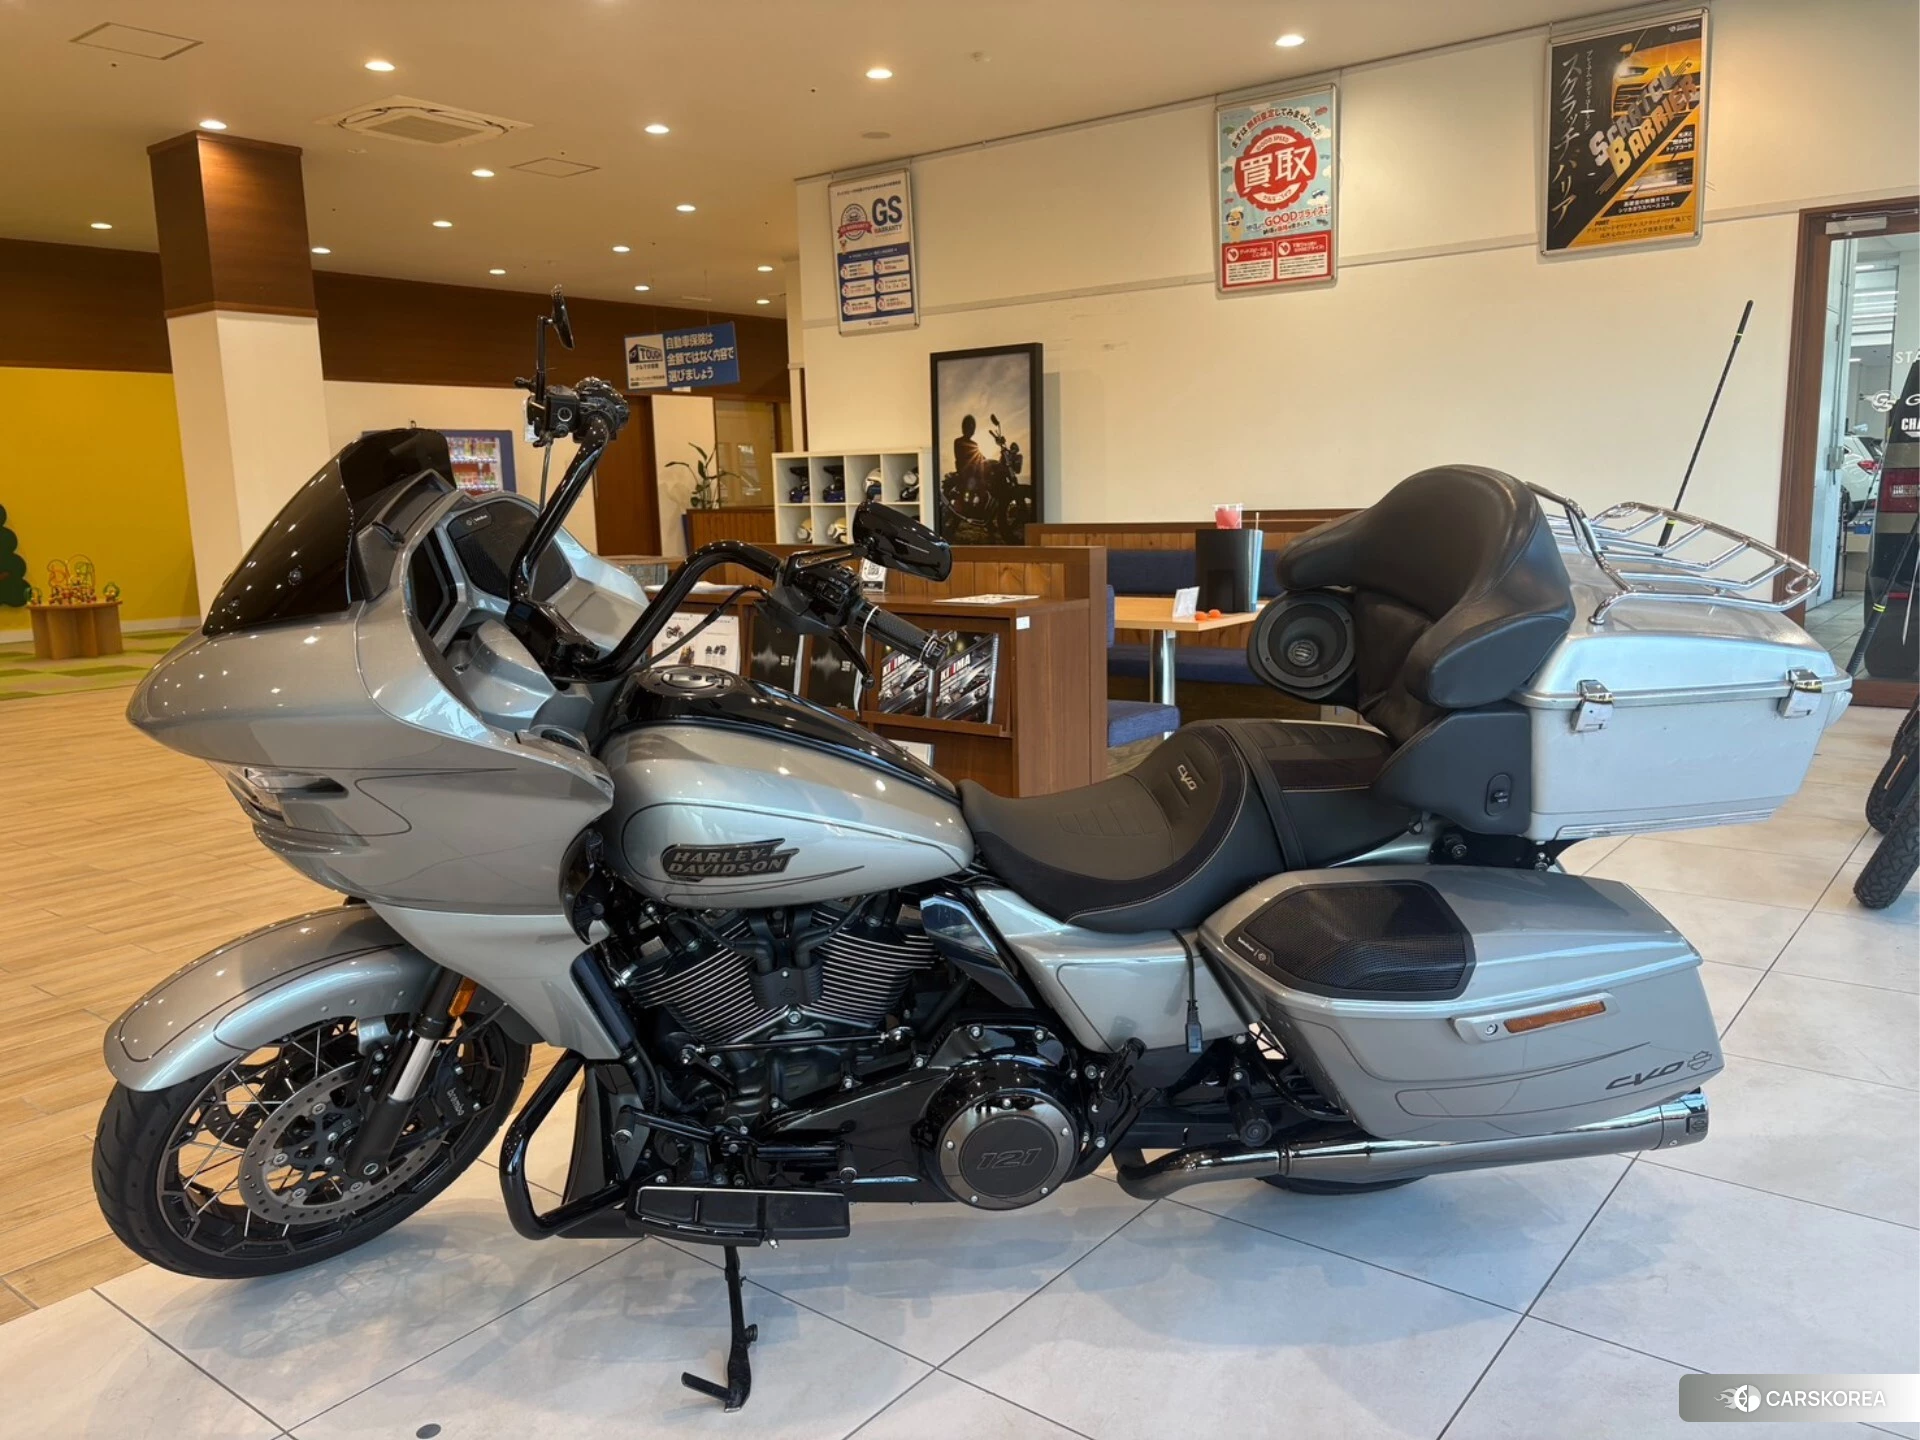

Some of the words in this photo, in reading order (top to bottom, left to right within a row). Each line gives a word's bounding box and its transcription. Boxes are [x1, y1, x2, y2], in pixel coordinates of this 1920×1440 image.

[1588, 64, 1677, 166] SCRATCH
[1606, 73, 1699, 178] BARRIER
[1240, 146, 1312, 194] 買取
[872, 195, 903, 227] GS
[666, 332, 714, 349] 自動車保険は
[667, 346, 735, 366] 金額ではなく内容で
[668, 366, 715, 383] 選びましょう
[1177, 764, 1198, 791] CVO
[667, 858, 785, 874] DAVIDSON
[1605, 1061, 1685, 1090] CVO
[447, 1087, 465, 1116] brembo
[976, 1147, 1043, 1170] 121
